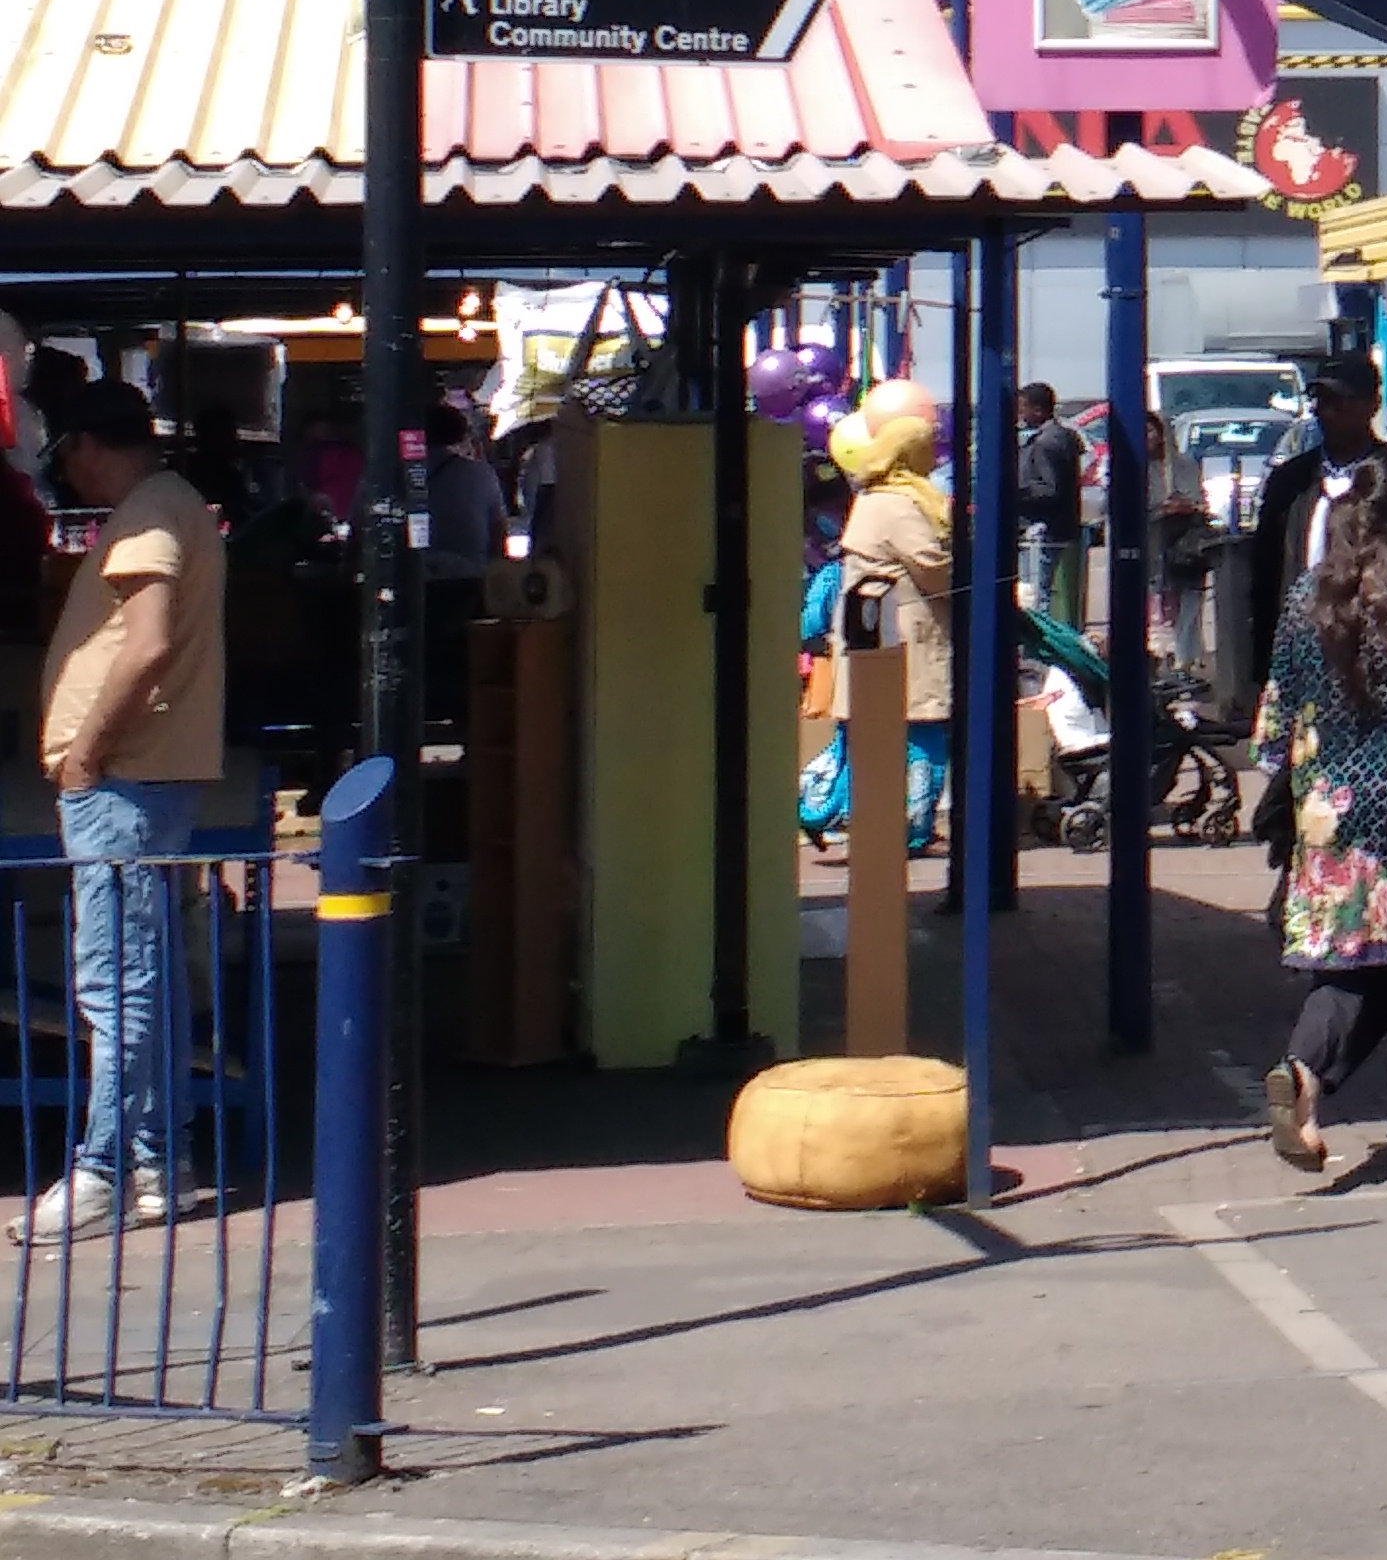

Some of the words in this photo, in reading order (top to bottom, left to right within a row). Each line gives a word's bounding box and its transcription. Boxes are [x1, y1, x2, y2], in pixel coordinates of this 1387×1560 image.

[488, 21, 648, 54] Community
[654, 25, 750, 52] Centre
[1284, 183, 1362, 219] WORLD
